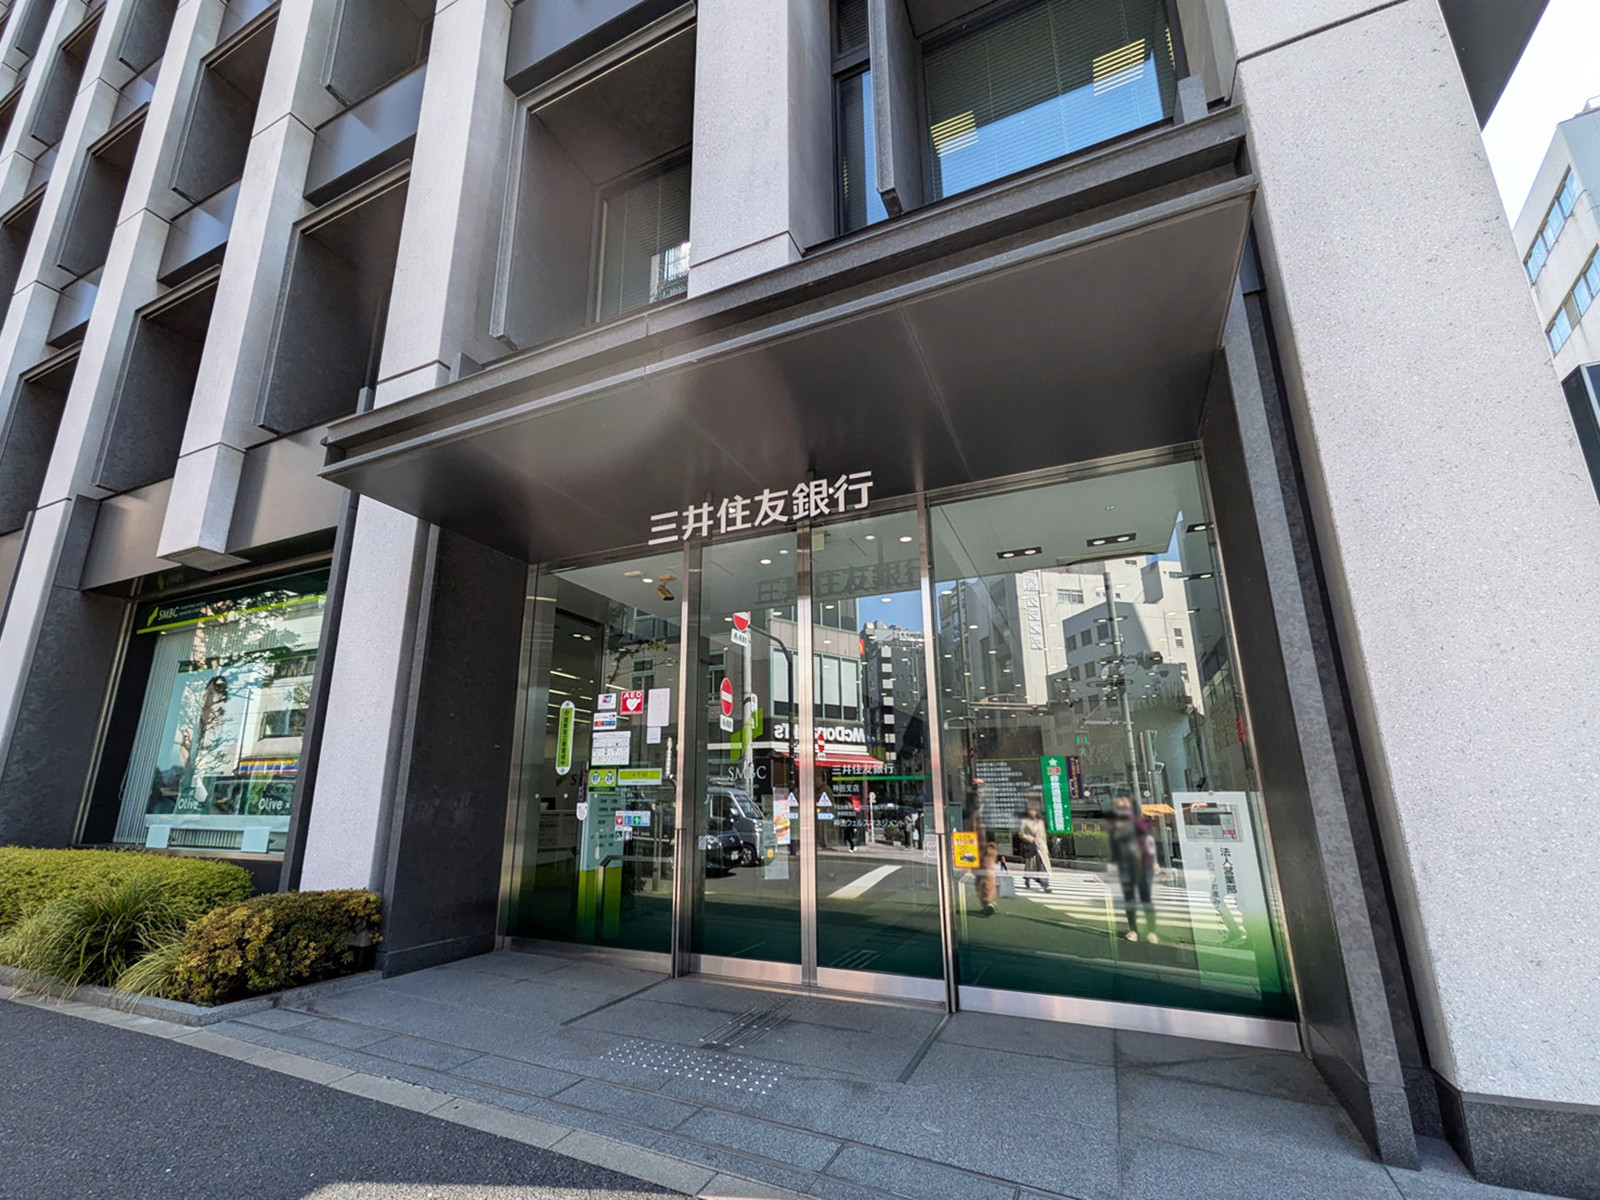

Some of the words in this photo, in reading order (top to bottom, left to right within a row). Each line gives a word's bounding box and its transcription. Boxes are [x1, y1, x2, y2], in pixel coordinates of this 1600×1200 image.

[648, 471, 873, 545] 三井住友銀行
[158, 606, 180, 620] SMBC
[832, 763, 895, 775] 三井住友銀行
[258, 797, 283, 810] Olive
